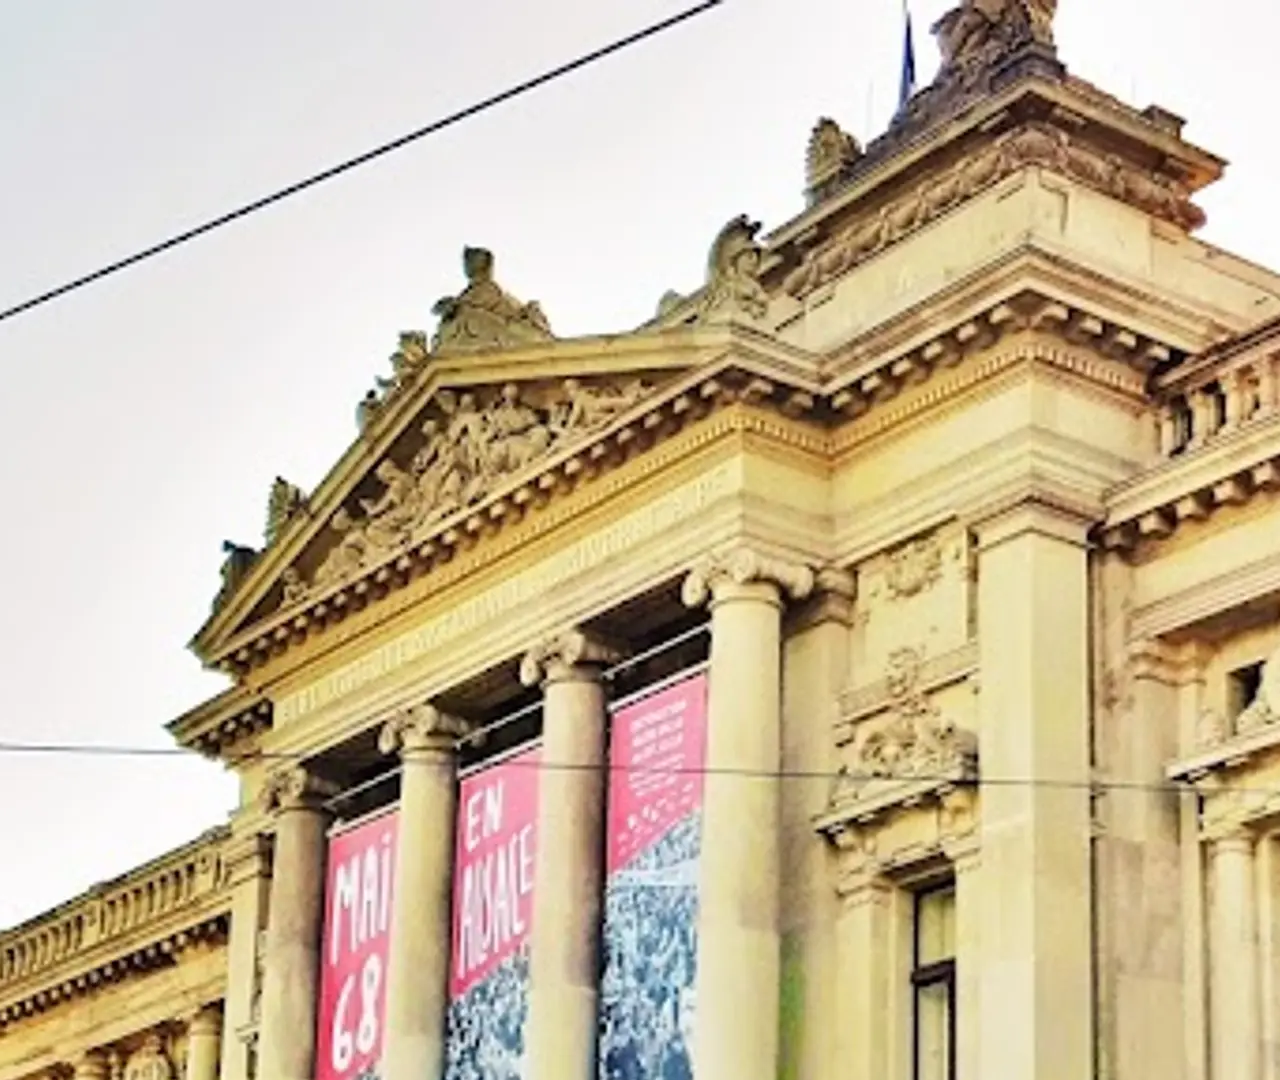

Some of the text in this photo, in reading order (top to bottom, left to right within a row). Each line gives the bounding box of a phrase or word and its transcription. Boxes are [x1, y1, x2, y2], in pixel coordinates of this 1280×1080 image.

[464, 778, 505, 852] EN
[458, 824, 533, 978] ALSACE
[332, 954, 382, 1072] 68
